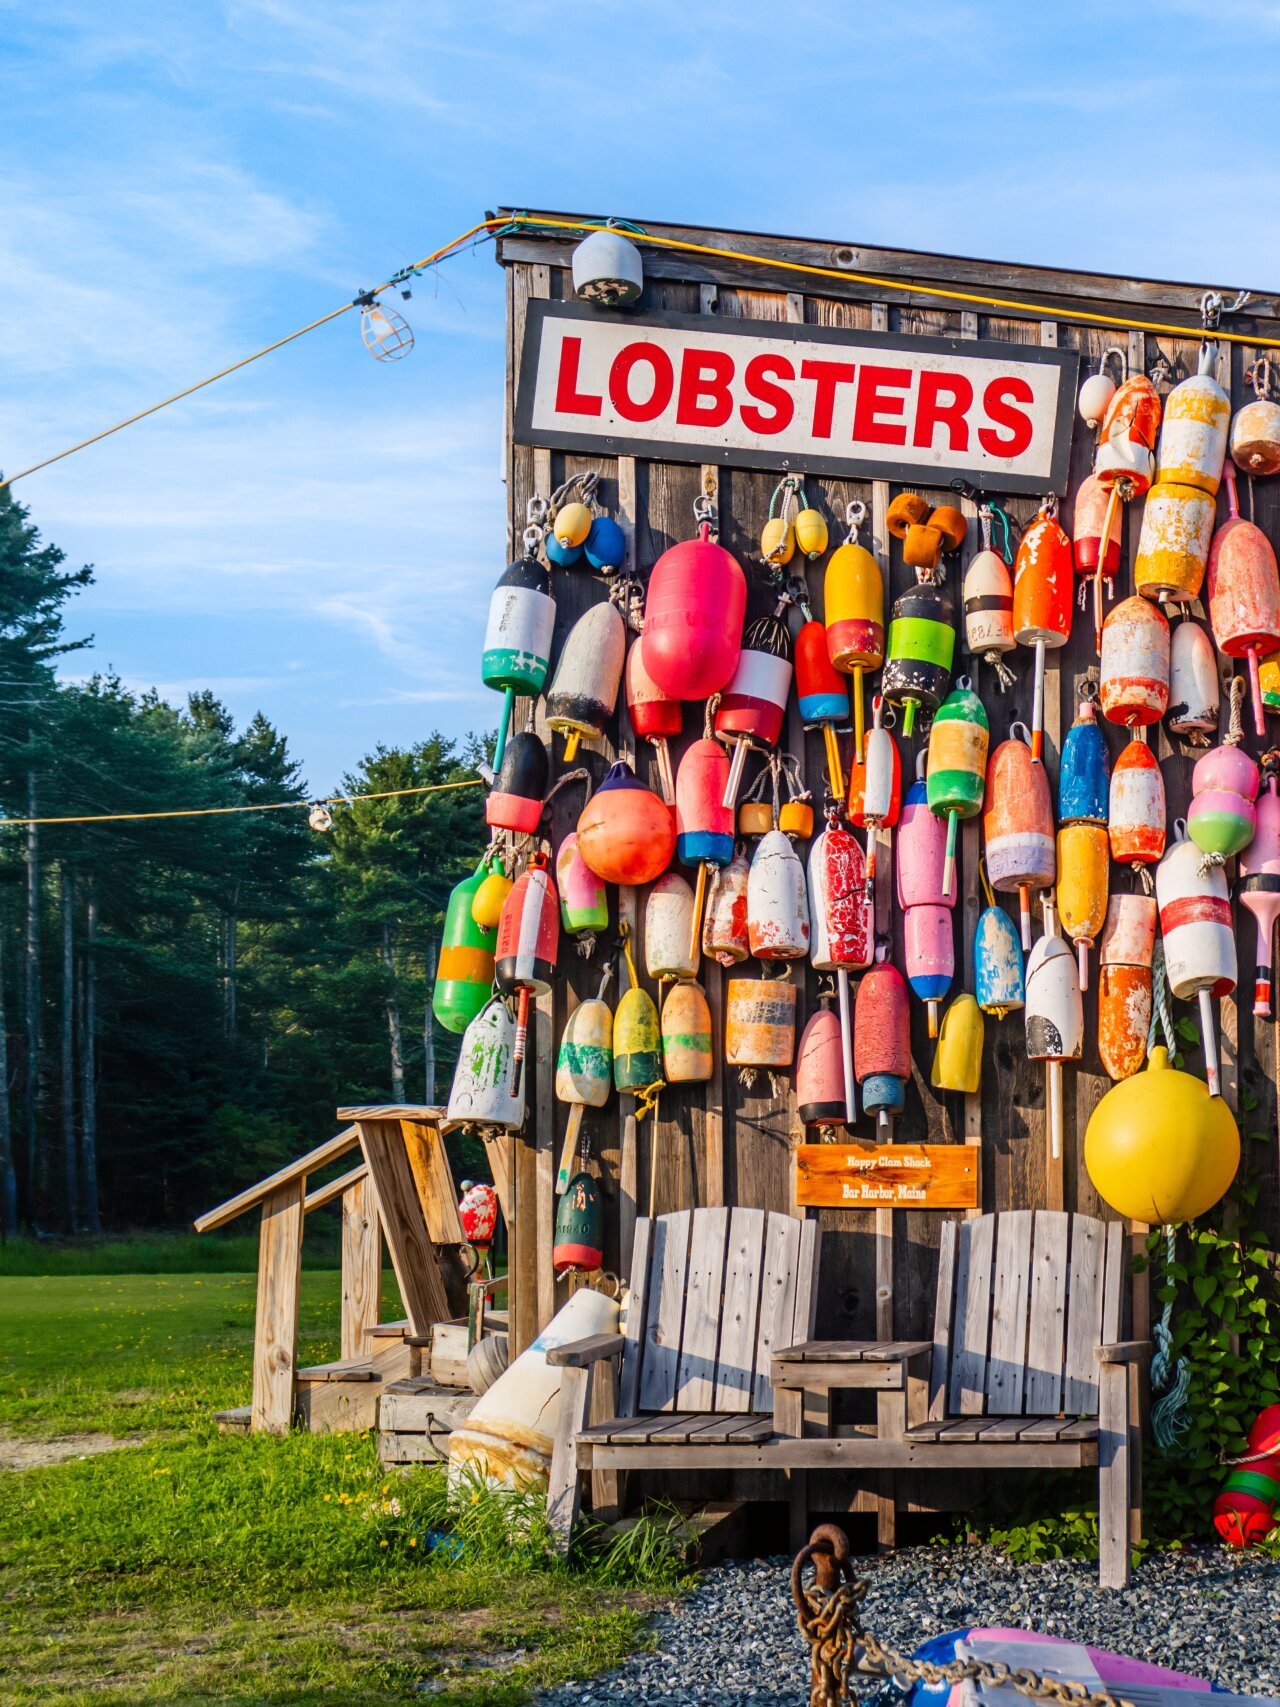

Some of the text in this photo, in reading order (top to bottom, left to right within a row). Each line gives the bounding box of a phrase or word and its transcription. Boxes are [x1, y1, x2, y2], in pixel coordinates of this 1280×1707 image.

[555, 336, 1034, 459] LOBSTERS
[847, 1155, 932, 1170] Happy Clam Shack
[842, 1183, 927, 1203] Bar Harbor, Maine
